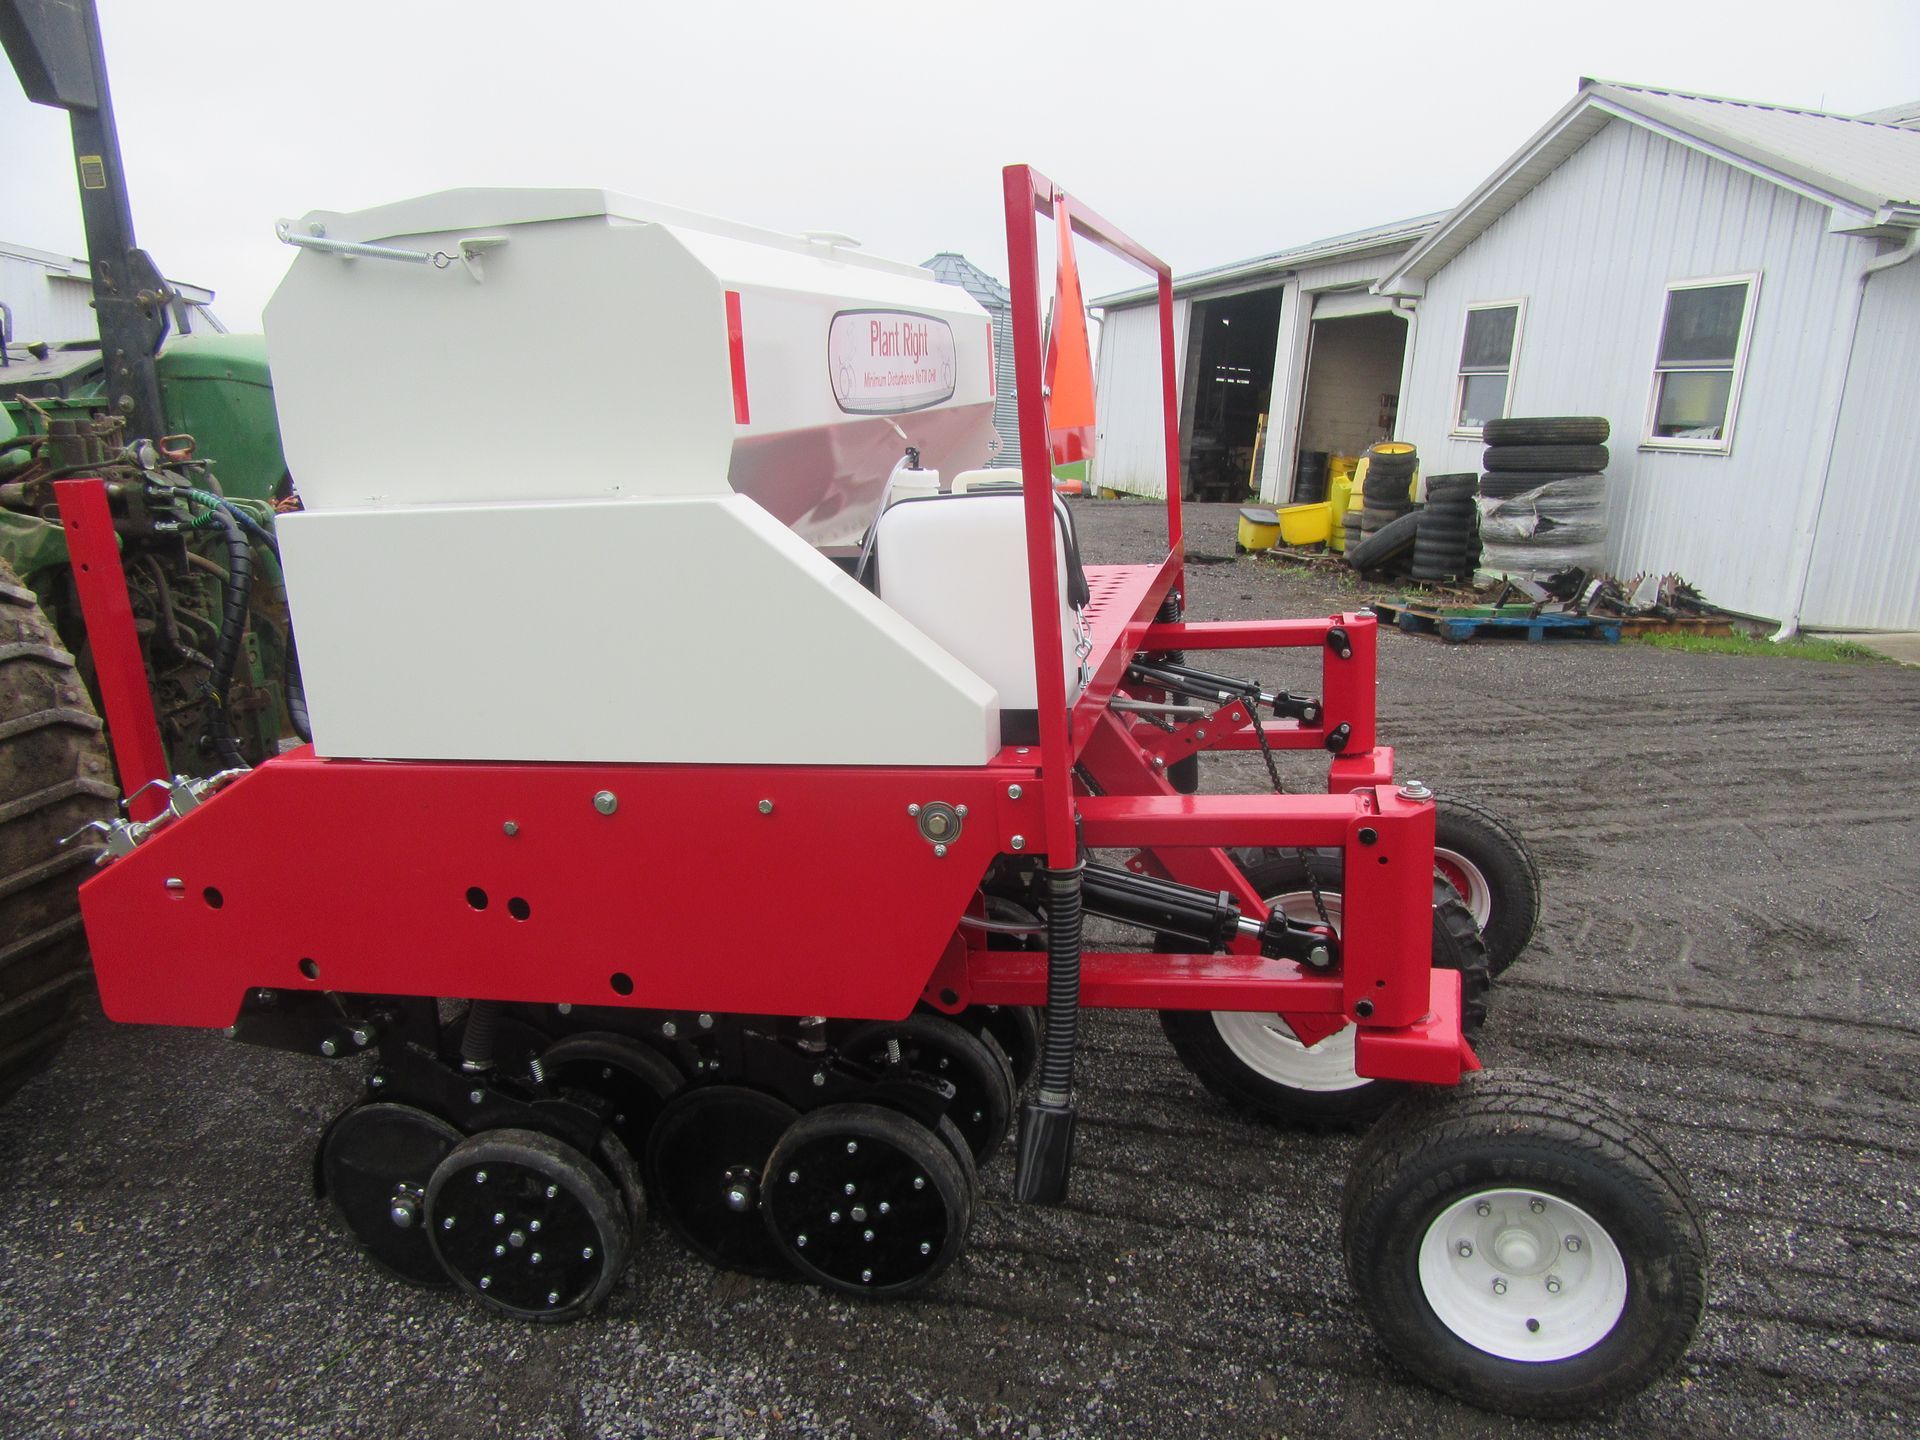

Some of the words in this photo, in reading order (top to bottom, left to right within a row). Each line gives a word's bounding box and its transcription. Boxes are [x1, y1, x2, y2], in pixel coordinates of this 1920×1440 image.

[870, 320, 899, 357] Plant
[903, 322, 928, 364] Right
[864, 371, 887, 388] Minimum
[888, 370, 914, 387] Disturbance
